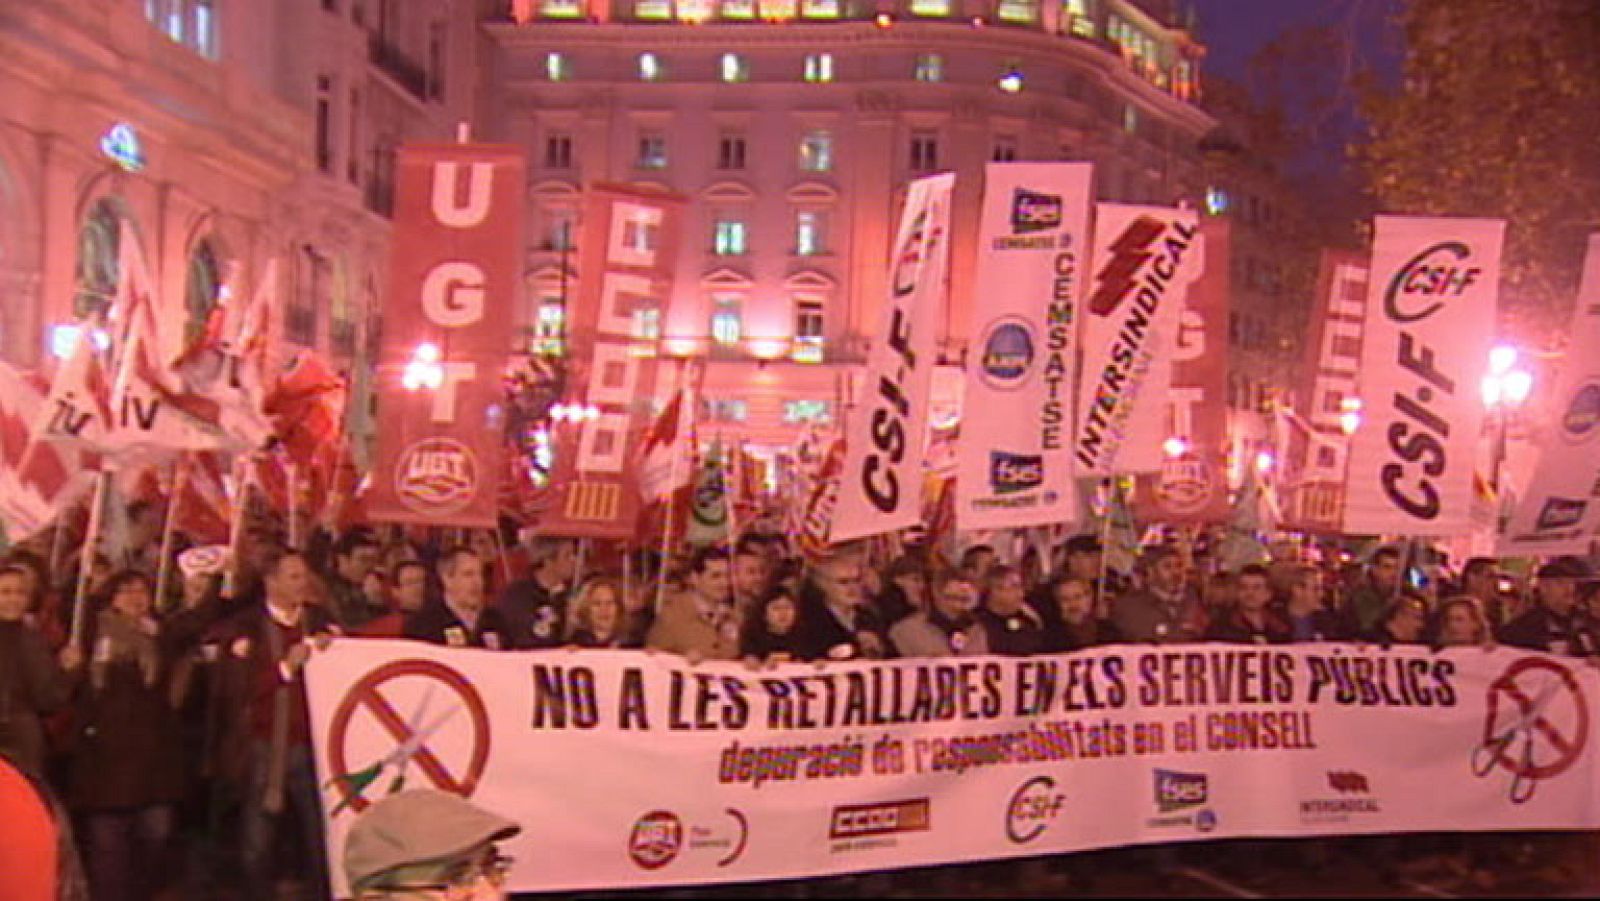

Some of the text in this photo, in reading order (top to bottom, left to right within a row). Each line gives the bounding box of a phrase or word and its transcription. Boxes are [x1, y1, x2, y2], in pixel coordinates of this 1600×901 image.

[422, 160, 494, 424] UGT
[1041, 253, 1075, 450] CEMSATSE
[1076, 220, 1199, 468] INTERSINDICAL
[531, 647, 1458, 730] NO A LES RETALLADES EN ELS SERVEIS PÚBLICS
[719, 736, 864, 788] depuració
[1173, 711, 1198, 752] el
[1206, 711, 1318, 751] CONSELL
